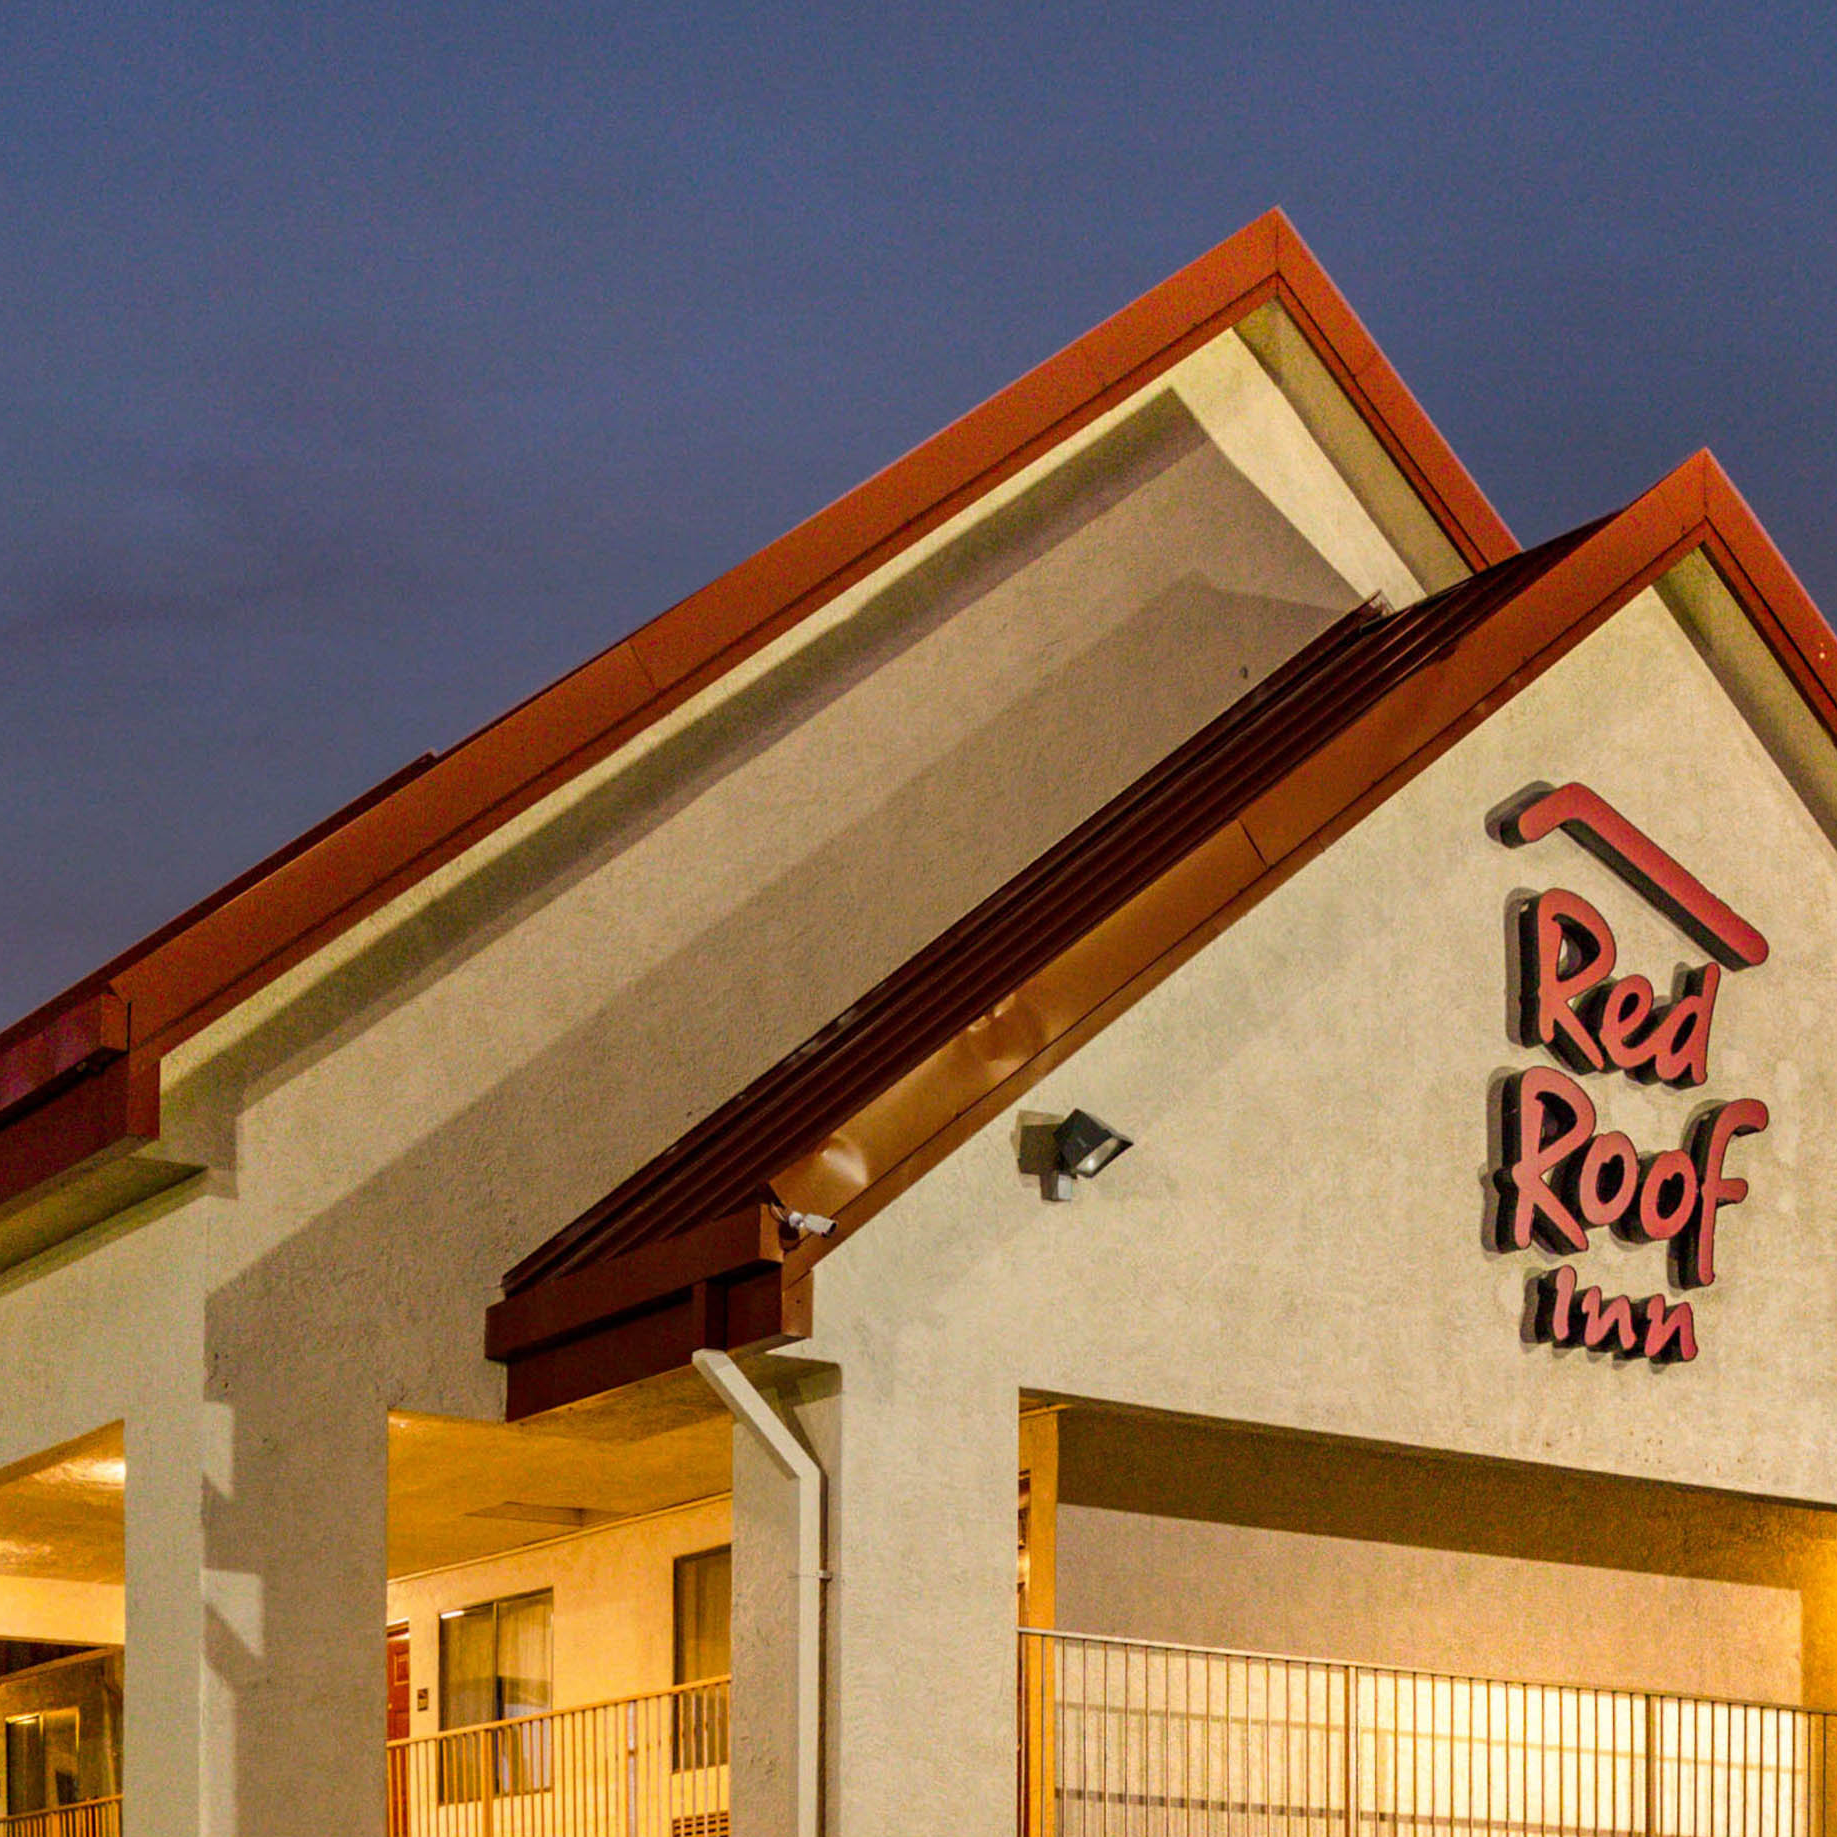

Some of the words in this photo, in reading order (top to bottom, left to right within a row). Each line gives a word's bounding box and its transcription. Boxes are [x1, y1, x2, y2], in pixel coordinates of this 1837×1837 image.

[1537, 887, 1721, 1086] Red
[1511, 1065, 1769, 1286] Roof
[1553, 1265, 1699, 1361] Inn
